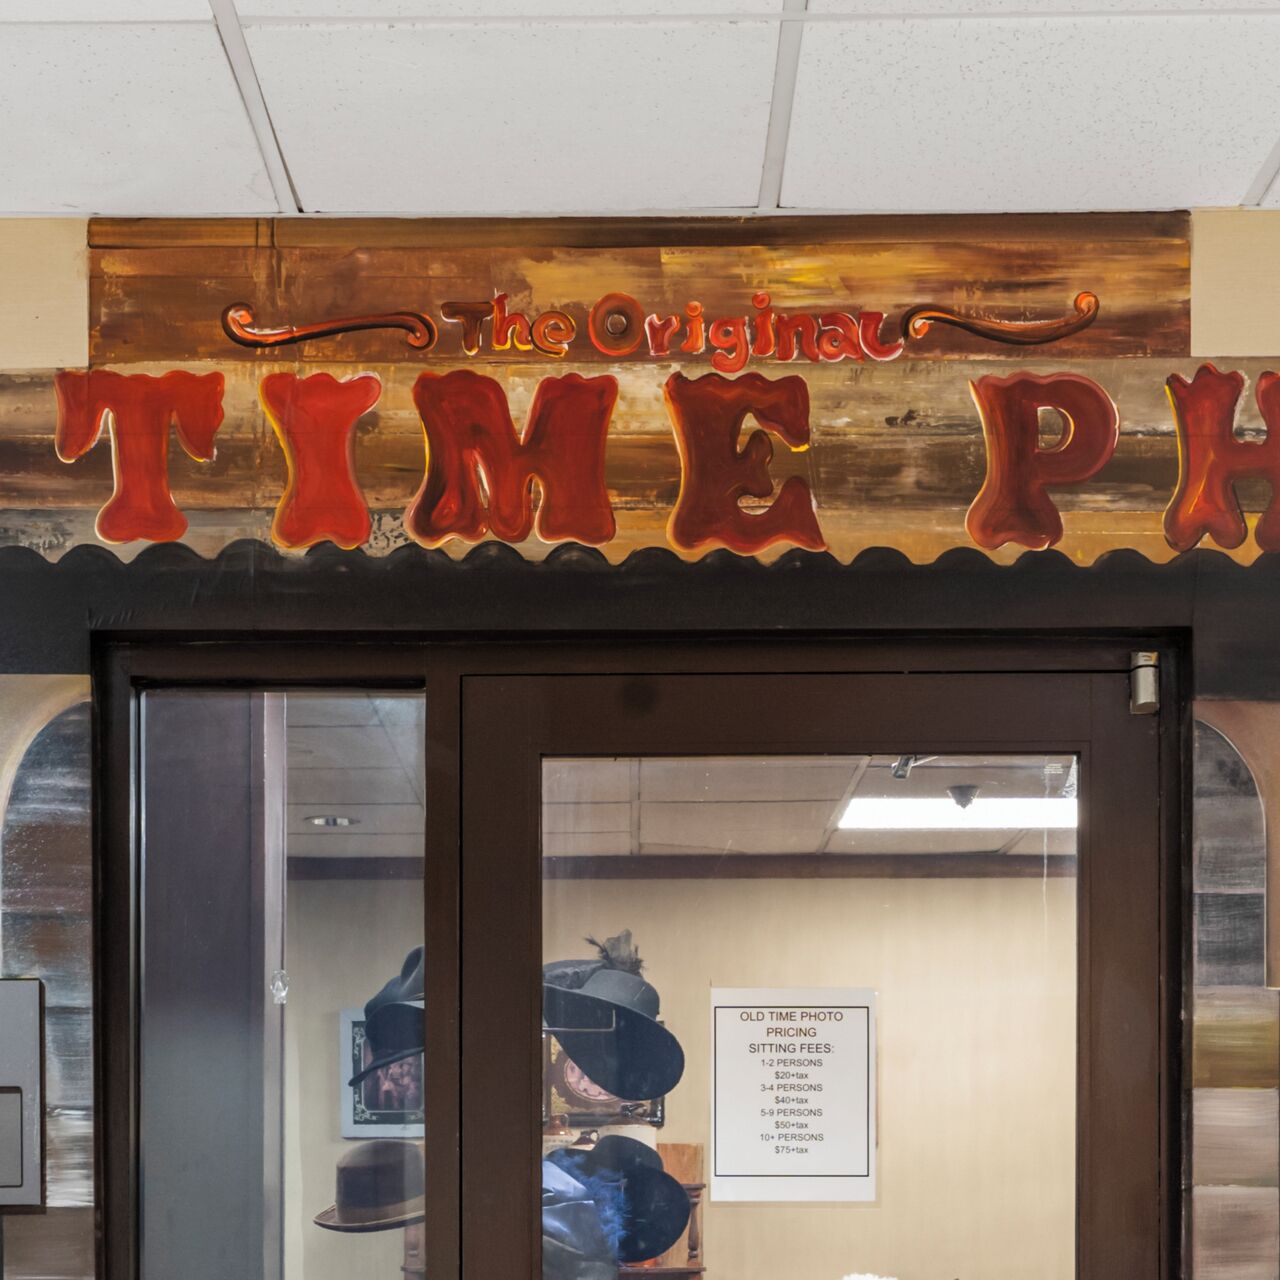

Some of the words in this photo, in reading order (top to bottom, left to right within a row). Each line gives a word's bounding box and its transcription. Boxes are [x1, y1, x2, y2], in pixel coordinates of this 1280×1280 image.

[440, 287, 576, 359] The
[588, 291, 904, 373] Original
[54, 370, 828, 556] TIME
[739, 1011, 765, 1022] OLD
[768, 1011, 797, 1022] TIME
[800, 1011, 844, 1022] PHOTO
[766, 1027, 817, 1038] PRICING
[748, 1043, 797, 1054] SITTING
[799, 1043, 835, 1054] FEES:
[760, 1058, 775, 1068] 1-2
[776, 1058, 823, 1068] PERSONS
[774, 1071, 809, 1081] $20+tax
[760, 1083, 775, 1093] 3-4
[776, 1083, 823, 1093] PERSONS
[774, 1095, 809, 1105] $40+tax
[760, 1108, 775, 1118] 5-9
[776, 1108, 823, 1118] PERSONS
[774, 1120, 809, 1130] $50+tax
[760, 1133, 776, 1142] 10+
[777, 1133, 824, 1142] PERSONS
[774, 1145, 809, 1155] $75+tax
